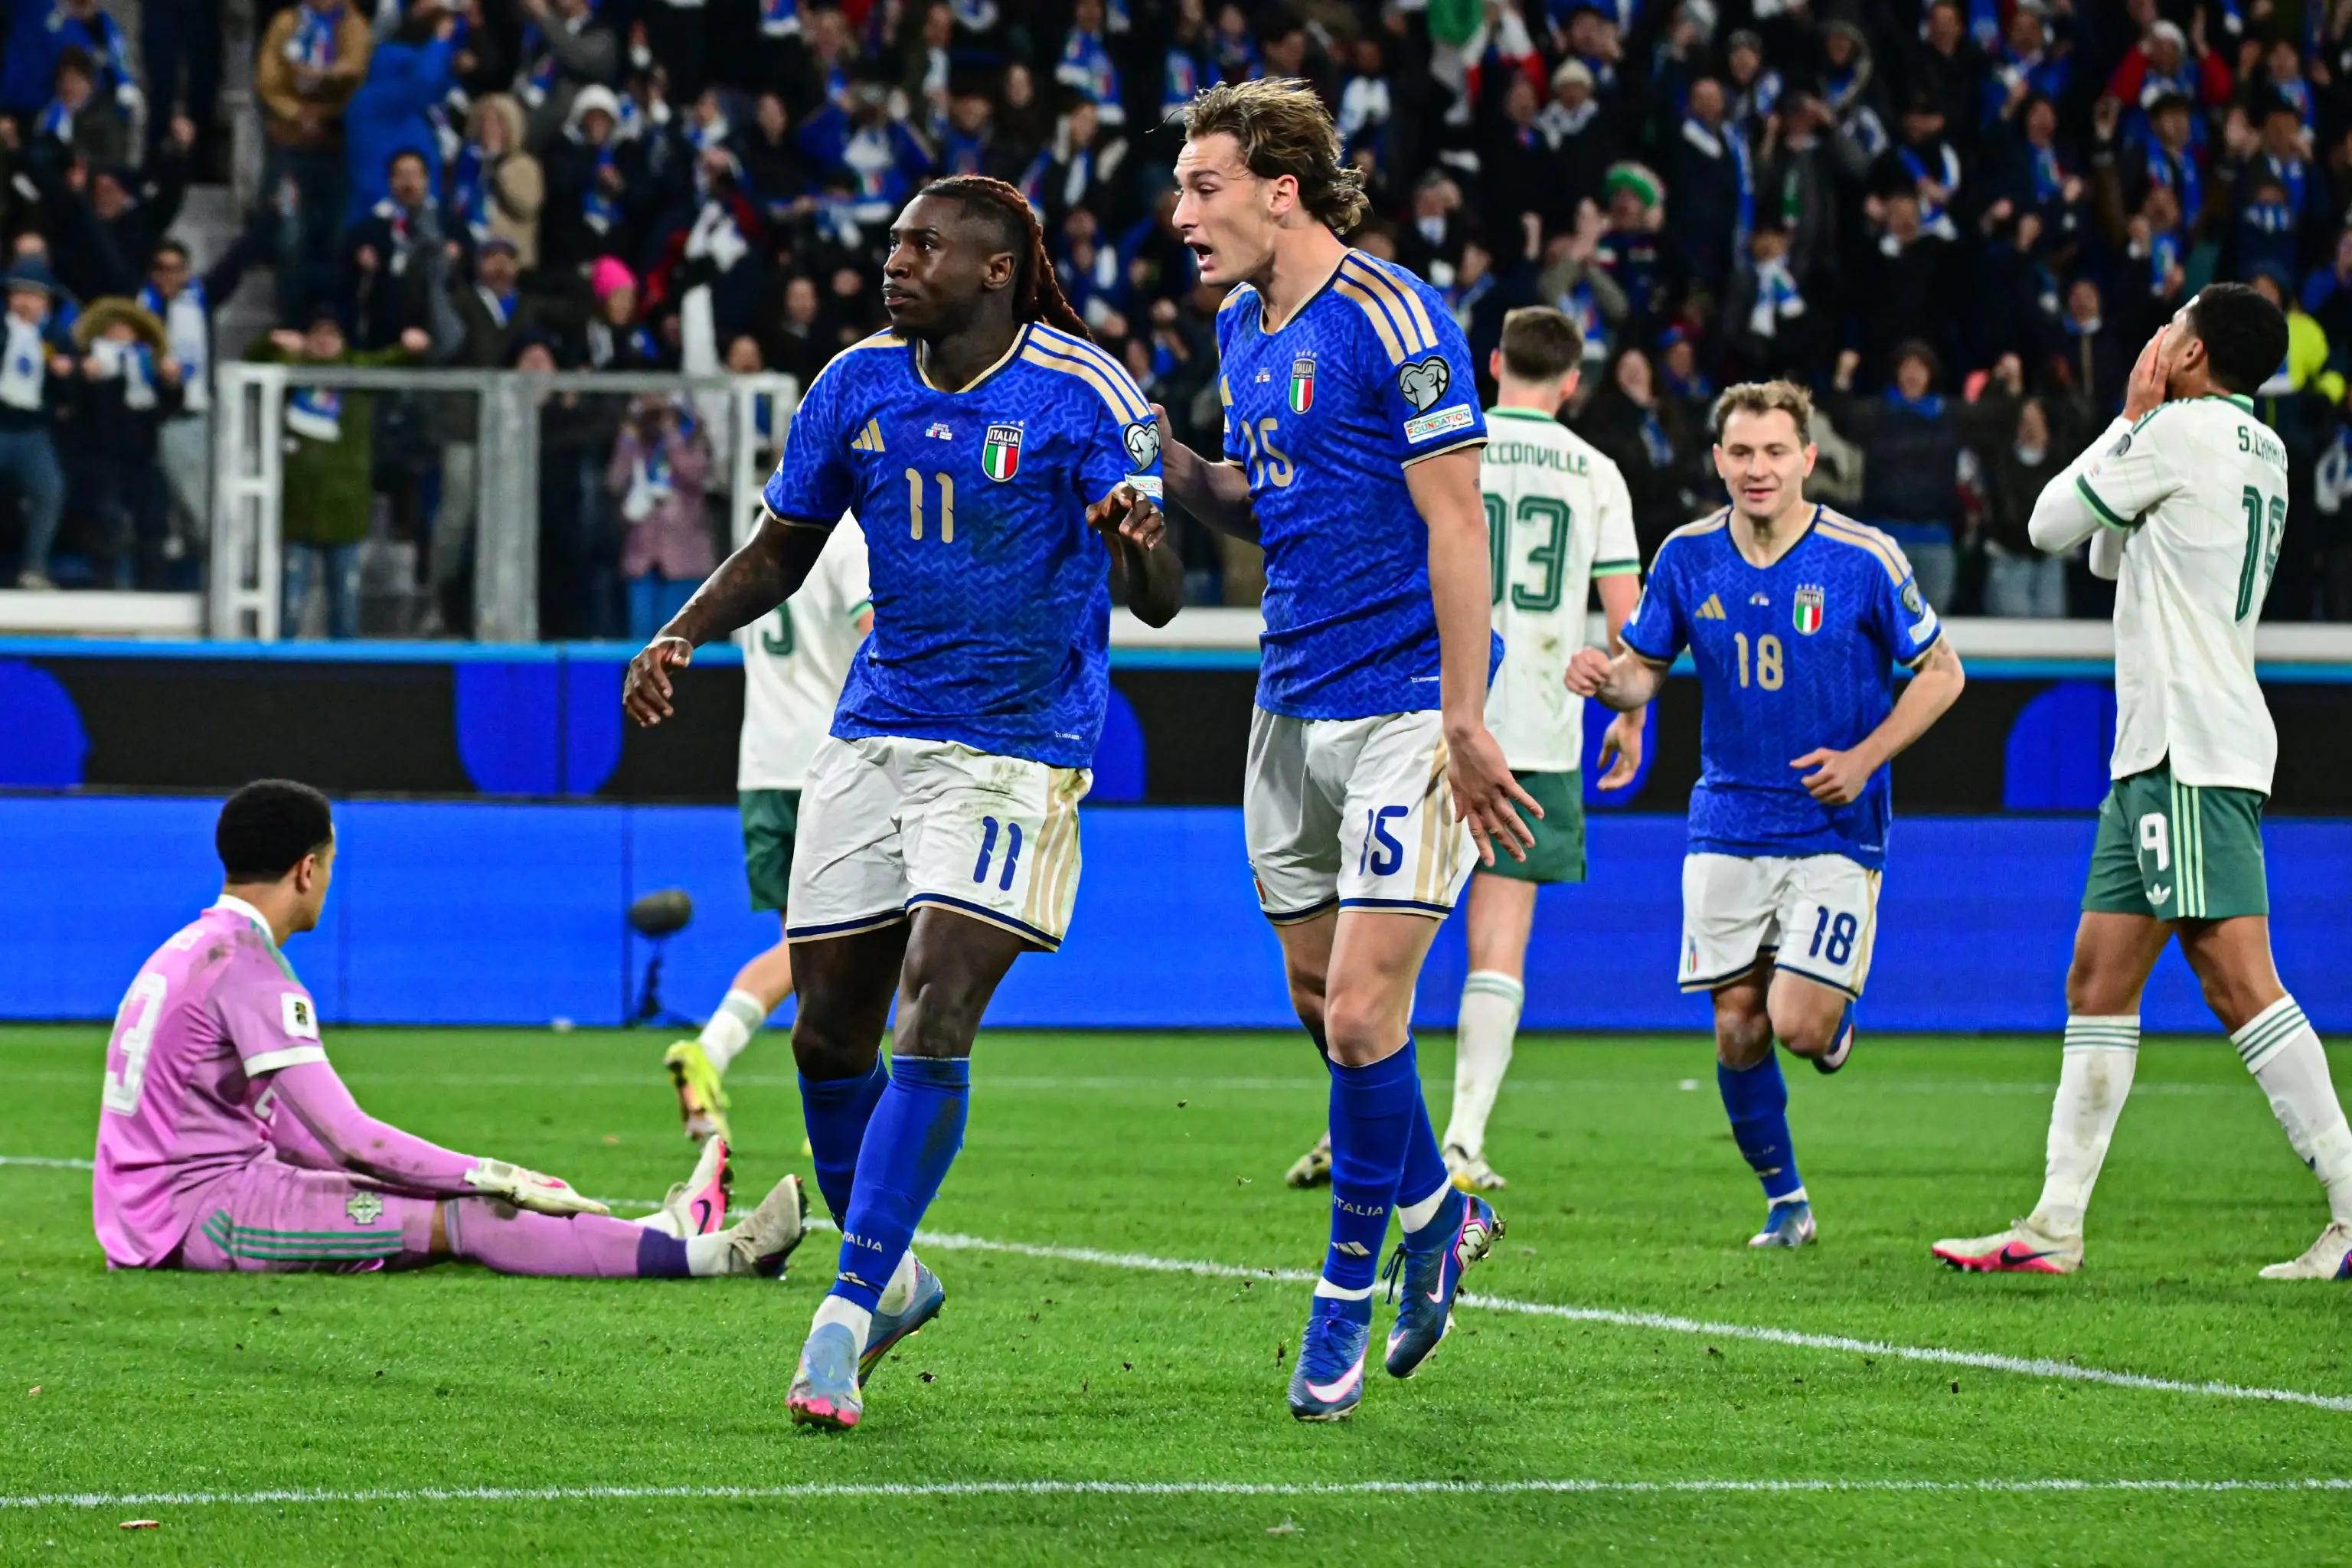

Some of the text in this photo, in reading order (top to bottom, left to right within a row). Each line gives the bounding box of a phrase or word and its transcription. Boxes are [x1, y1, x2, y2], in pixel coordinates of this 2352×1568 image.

[1294, 364, 1312, 374] ITALIA
[989, 430, 1018, 443] ITALIA
[1241, 418, 1293, 488] 15
[1408, 412, 1471, 436] FOUNDATION
[905, 468, 954, 544] 11
[1734, 632, 1784, 691] 18
[973, 815, 1023, 891] 11
[1358, 805, 1409, 877] 15
[2138, 812, 2170, 871] 9
[1808, 905, 1857, 966] 18
[104, 972, 168, 1117] 3
[1334, 1194, 1383, 1216] ITALIA
[843, 1231, 882, 1253] ITALIA
